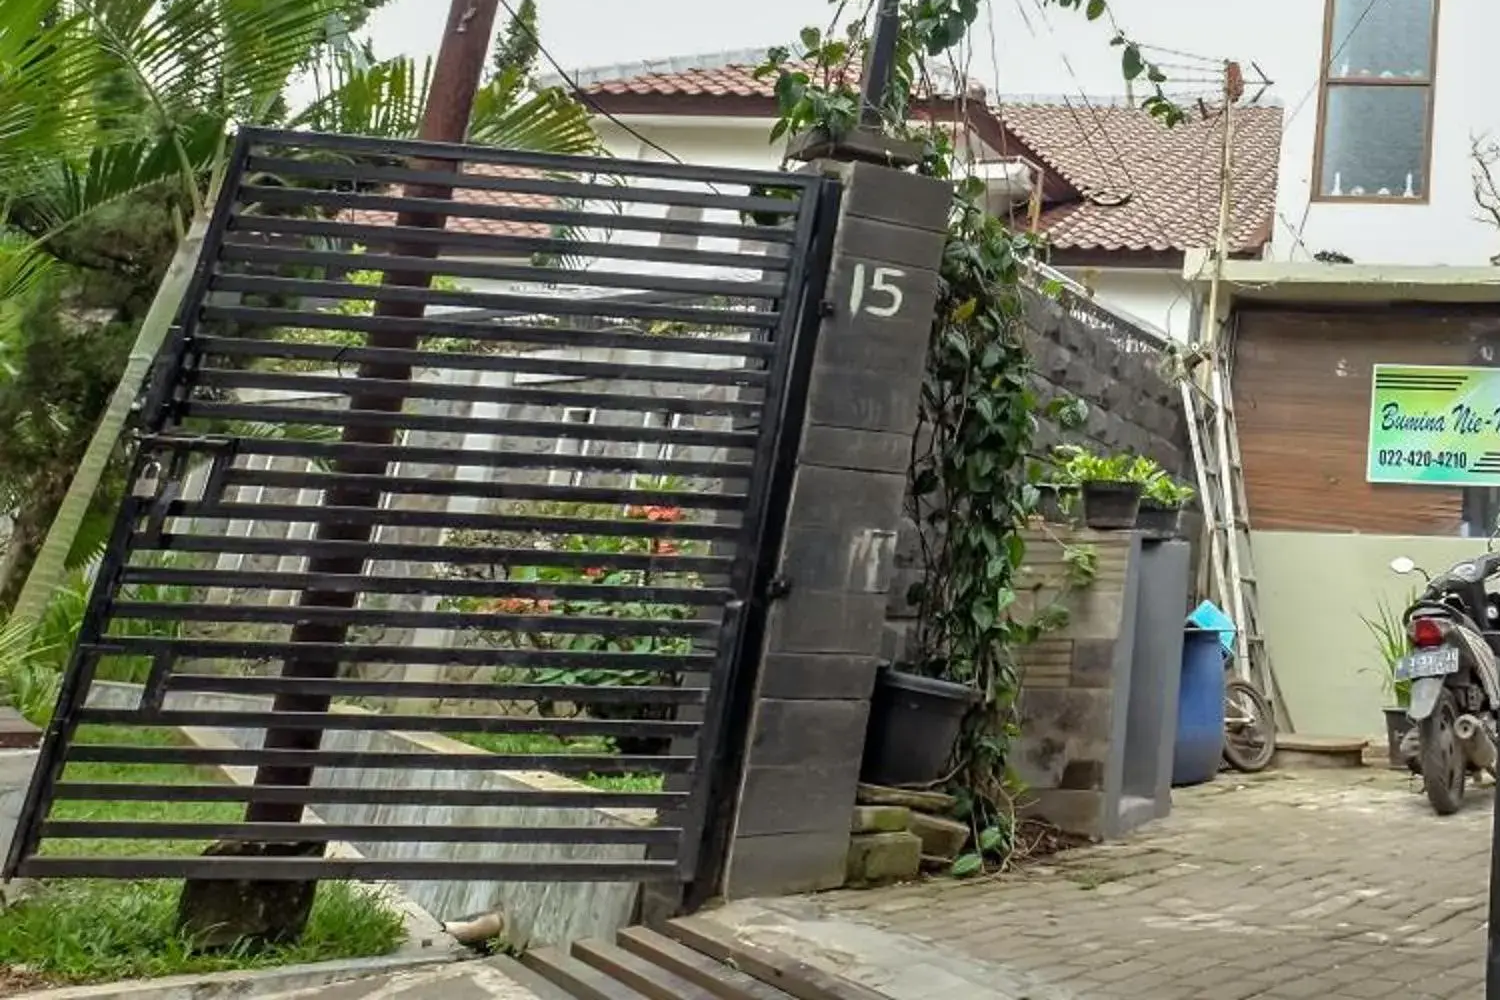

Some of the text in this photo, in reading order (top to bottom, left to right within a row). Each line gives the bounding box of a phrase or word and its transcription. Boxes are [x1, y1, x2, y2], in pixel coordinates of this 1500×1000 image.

[849, 264, 904, 318] 15
[1381, 402, 1445, 432] Bumina
[1379, 449, 1467, 467] 022-420-4210
